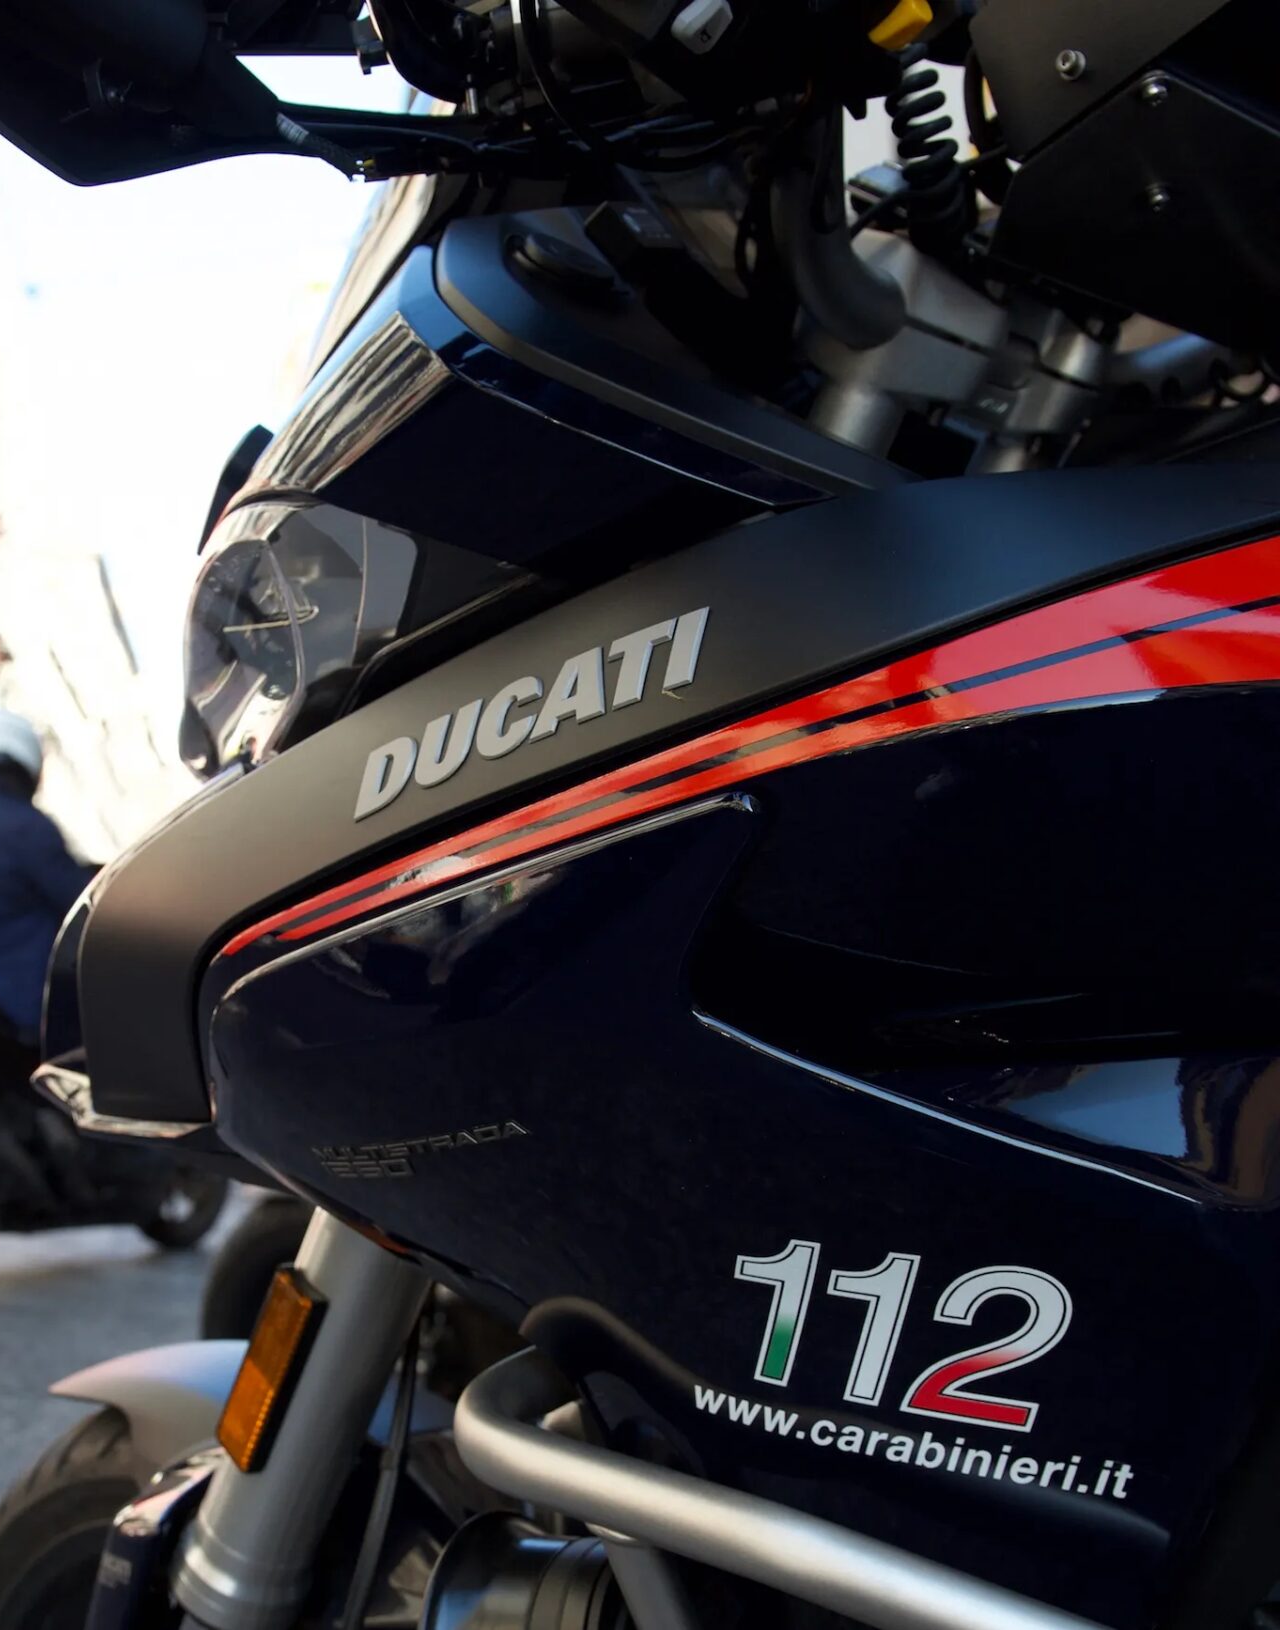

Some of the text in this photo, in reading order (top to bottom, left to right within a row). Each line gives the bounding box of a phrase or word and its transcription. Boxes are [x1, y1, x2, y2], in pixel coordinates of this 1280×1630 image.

[354, 605, 710, 823] DUCATI
[733, 1239, 1073, 1433] 112
[693, 1384, 1135, 1498] www.carabinieri.it
